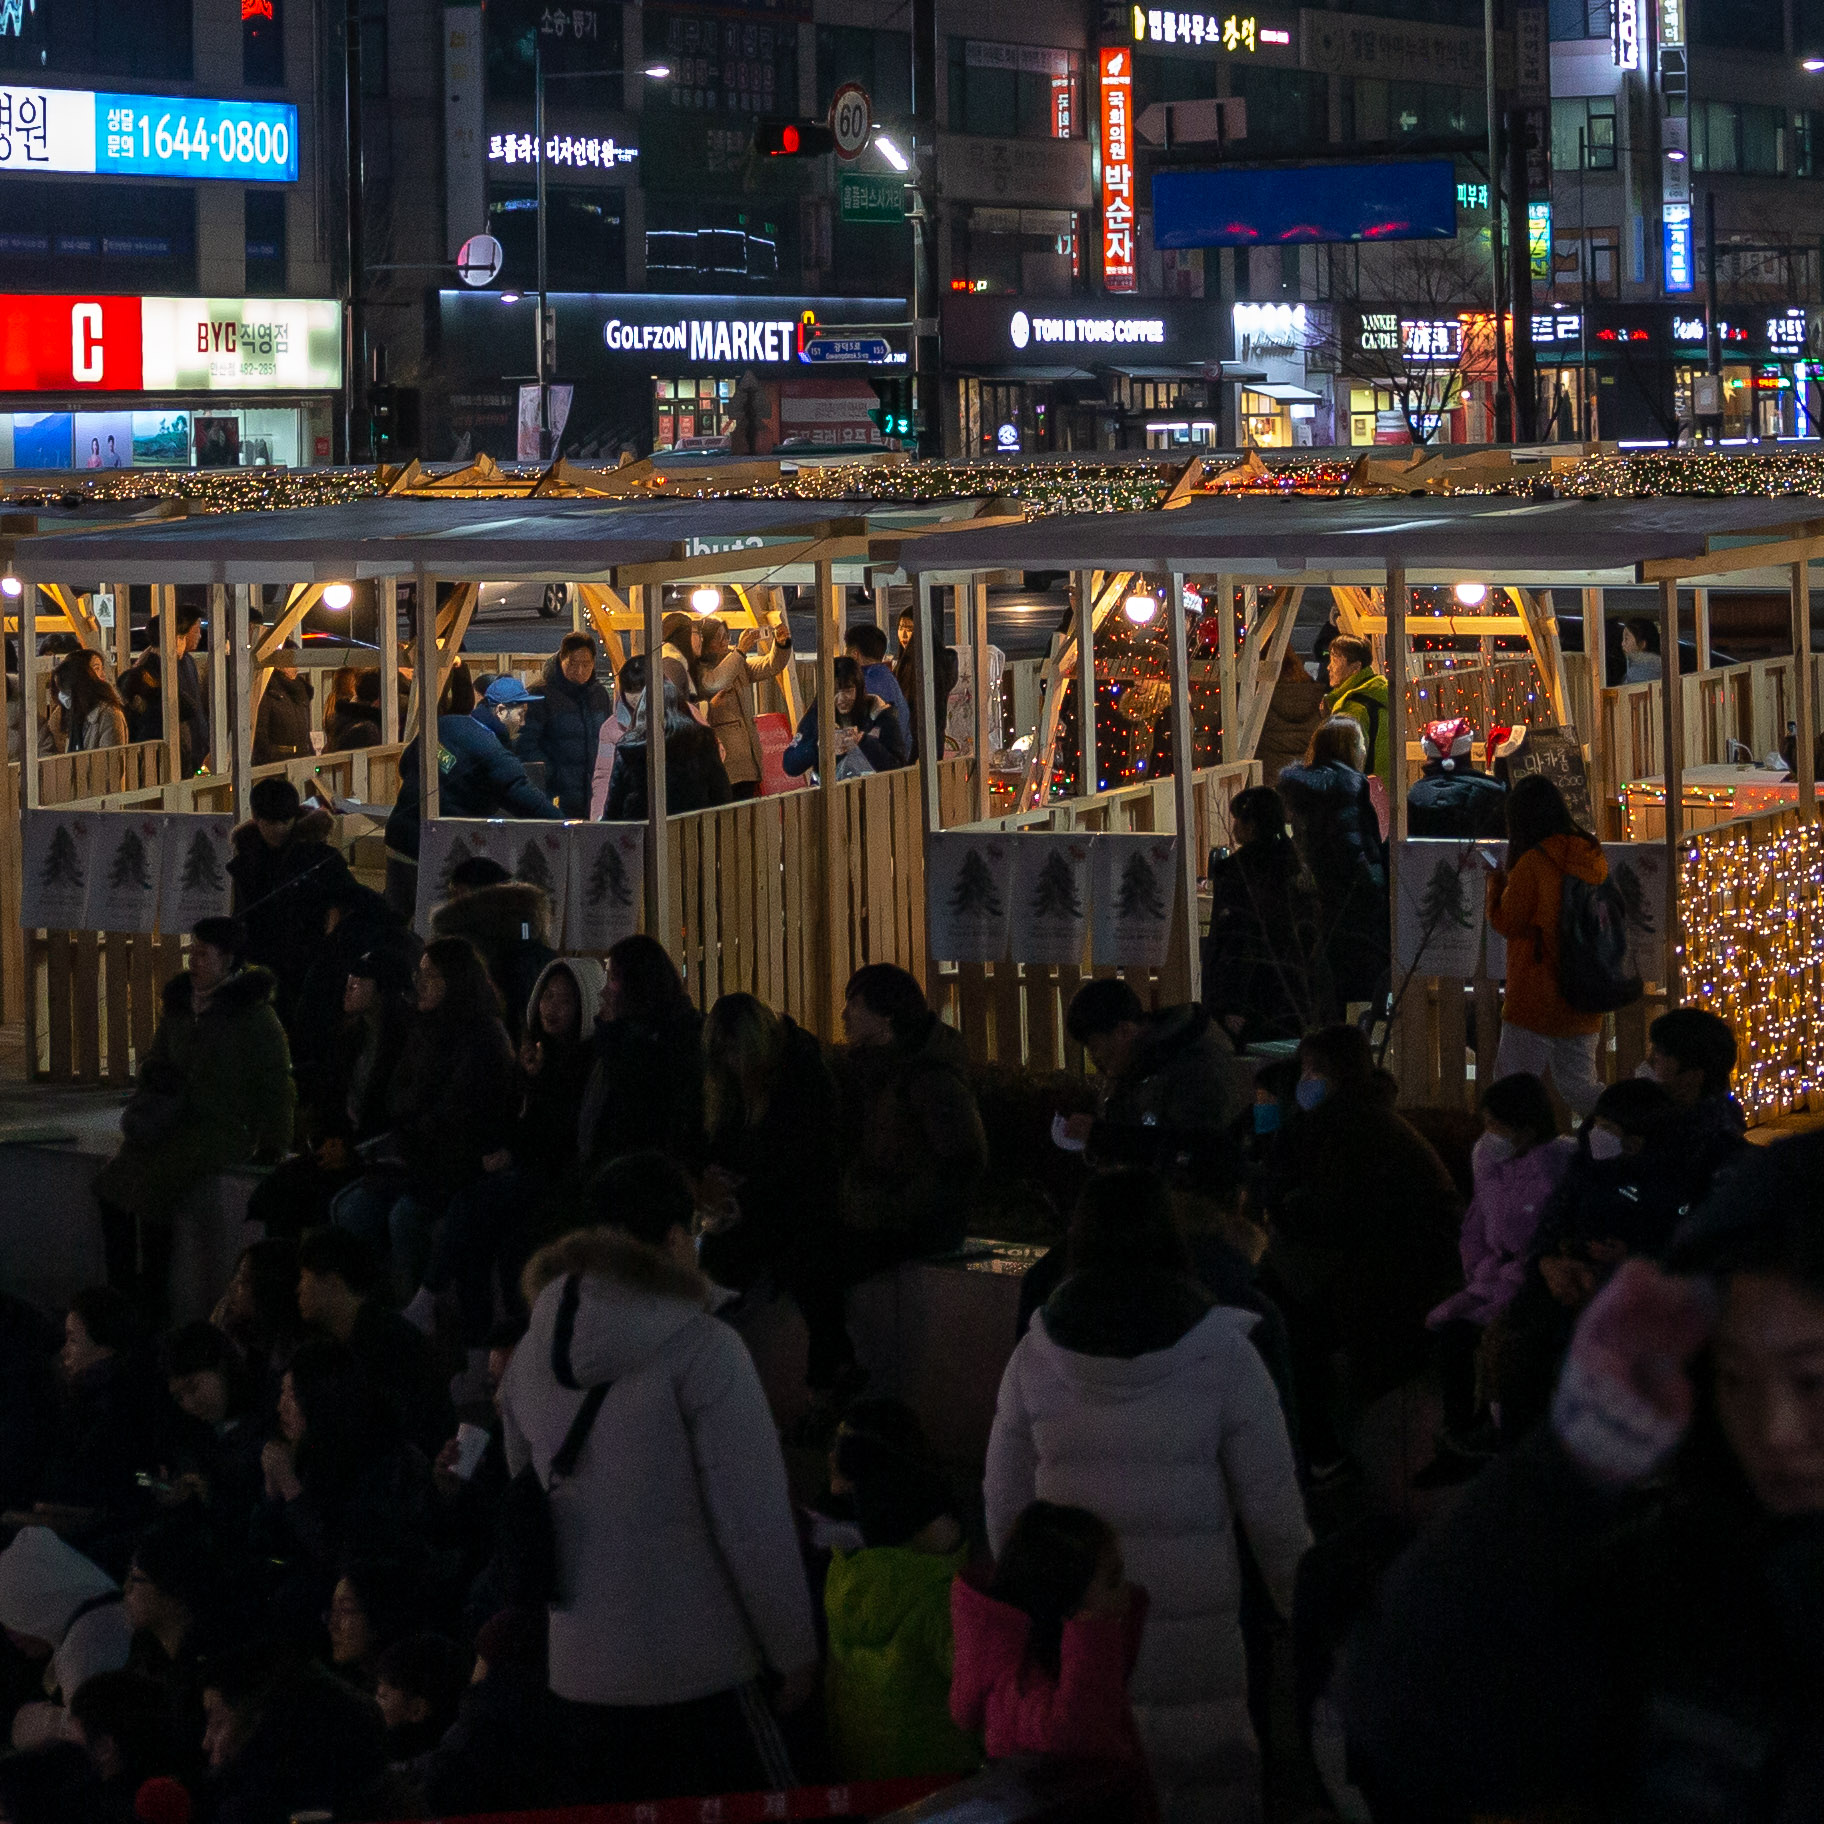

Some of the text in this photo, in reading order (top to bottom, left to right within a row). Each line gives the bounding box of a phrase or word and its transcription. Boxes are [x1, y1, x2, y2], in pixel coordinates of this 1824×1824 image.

[839, 105, 863, 139] 60
[1457, 182, 1488, 211] 피부과
[1105, 164, 1133, 263] 박순자
[1033, 319, 1063, 342] TOM
[1076, 319, 1114, 343] TOMS
[1114, 320, 1165, 343] COFFEE
[1361, 315, 1397, 330] YANKEE
[198, 322, 288, 354] BYC 직영점
[605, 319, 795, 362] GOLFZON MARKET
[1361, 332, 1398, 349] CANDLE
